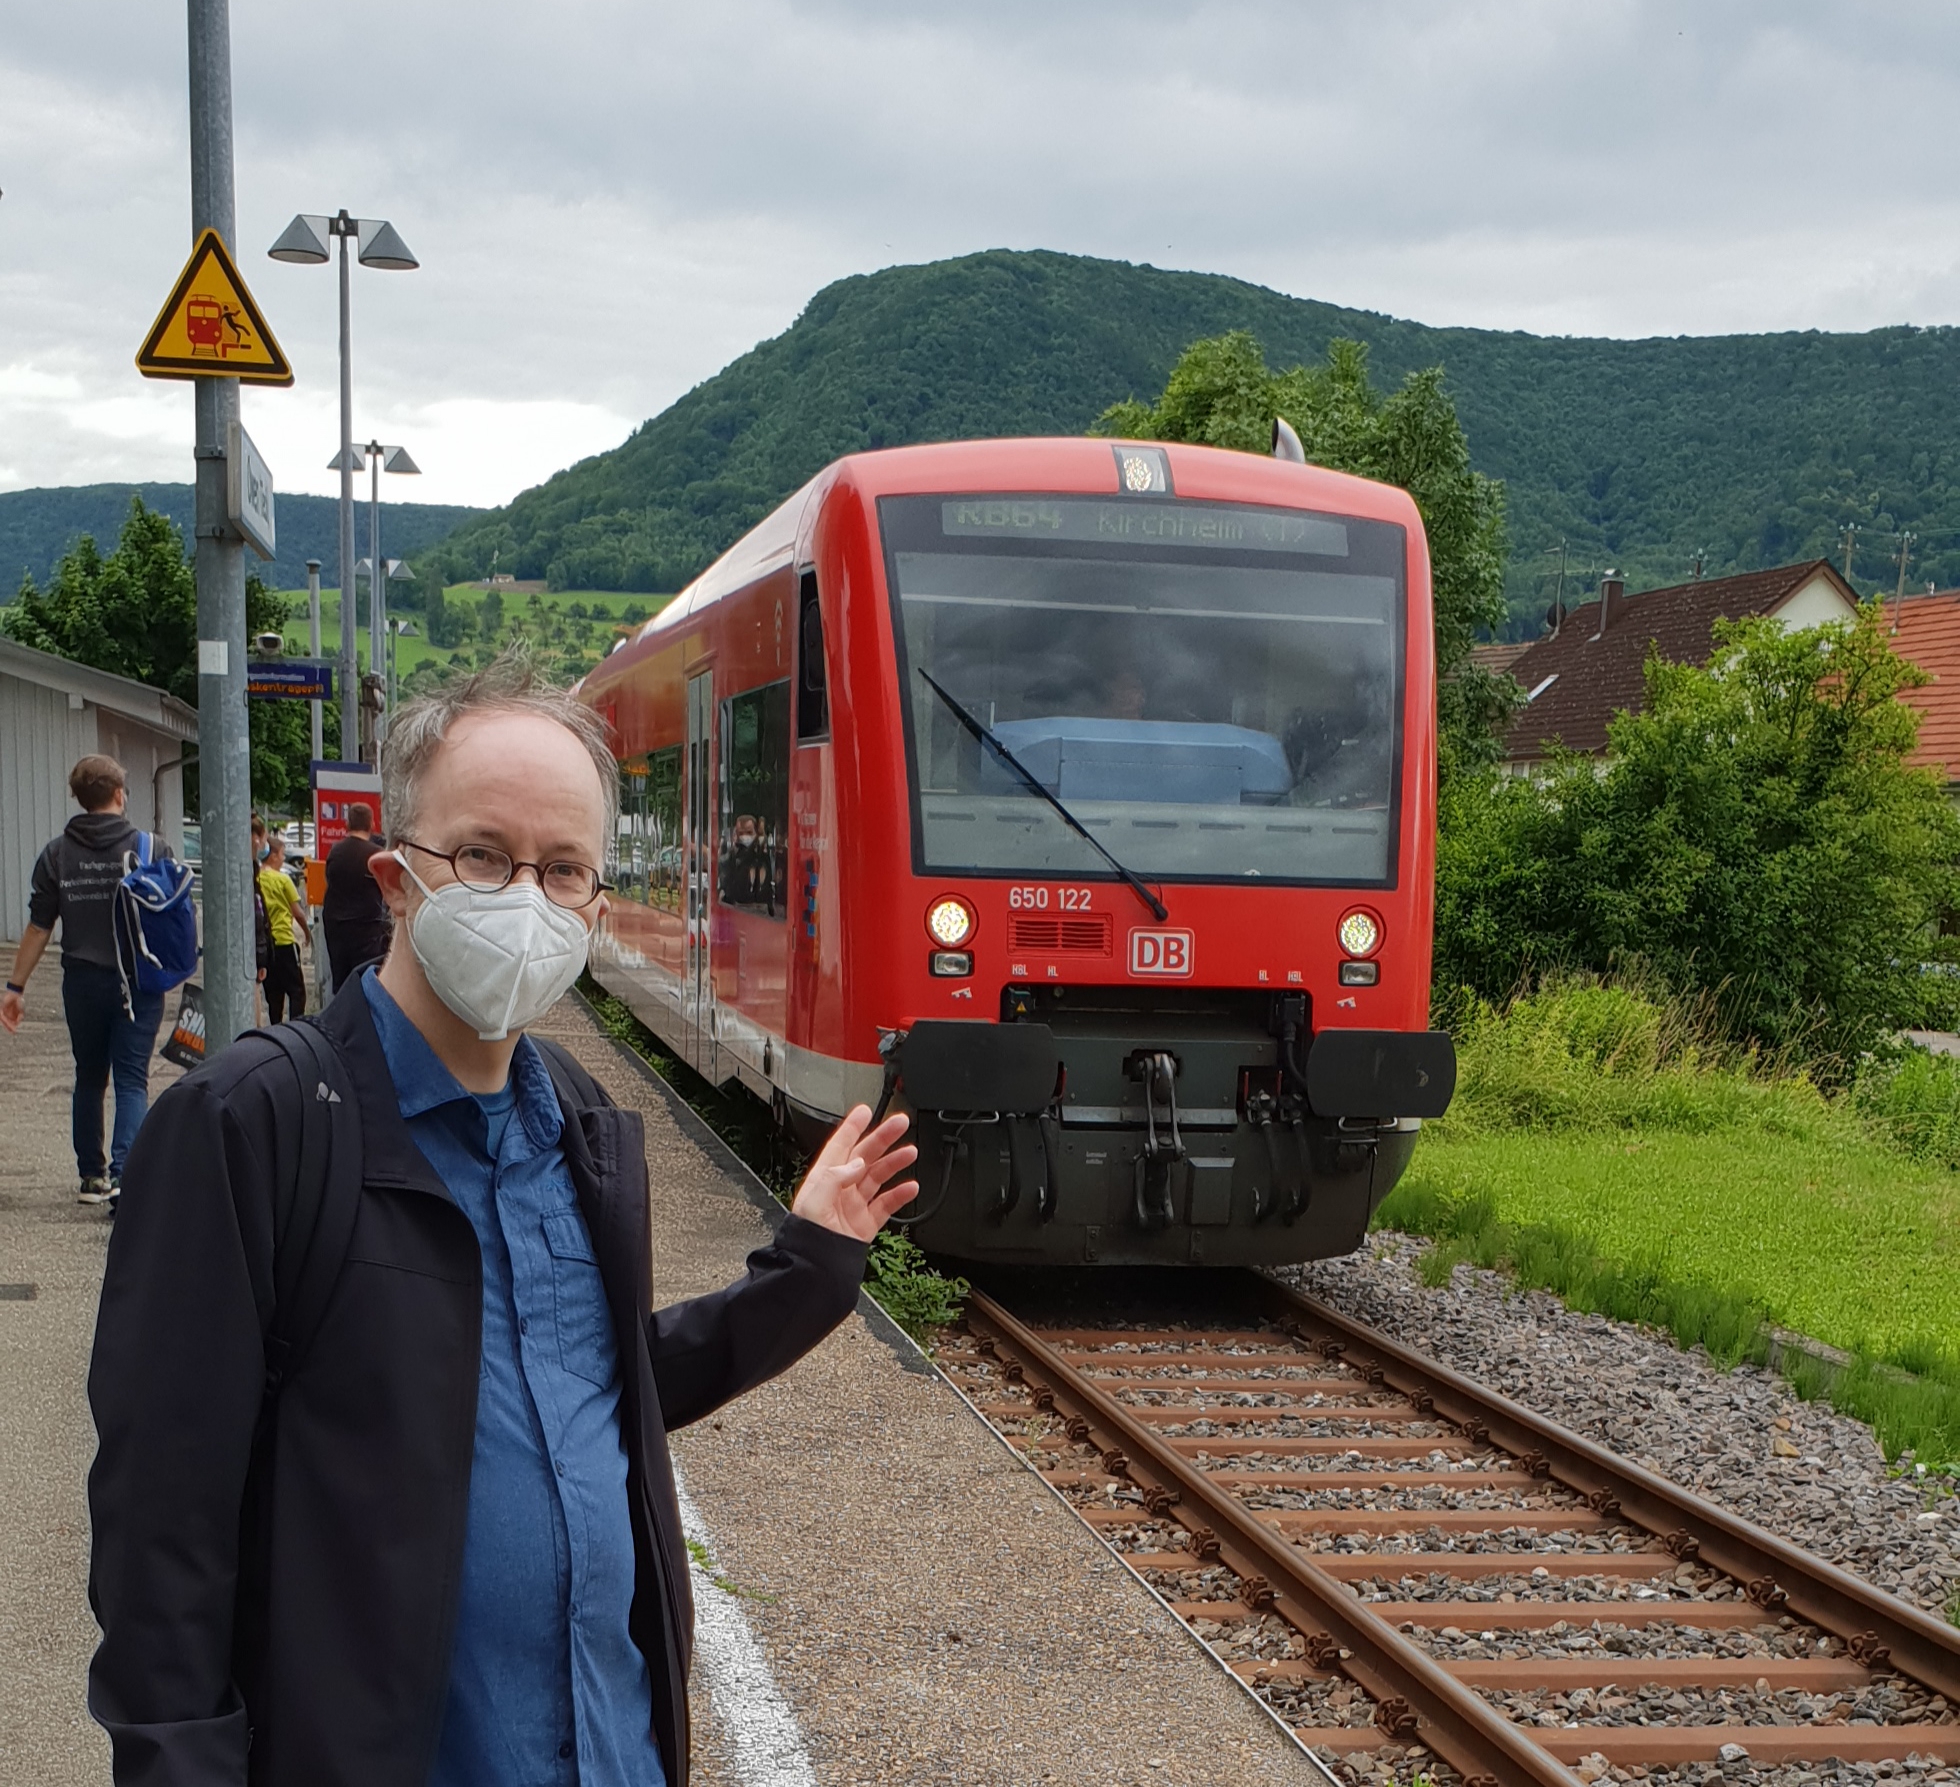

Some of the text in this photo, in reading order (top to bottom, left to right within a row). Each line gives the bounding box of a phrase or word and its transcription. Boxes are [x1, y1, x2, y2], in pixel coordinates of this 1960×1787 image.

[1097, 508, 1243, 540] Kirchheim
[1009, 886, 1092, 910] 650 122
[1137, 935, 1185, 969] DB
